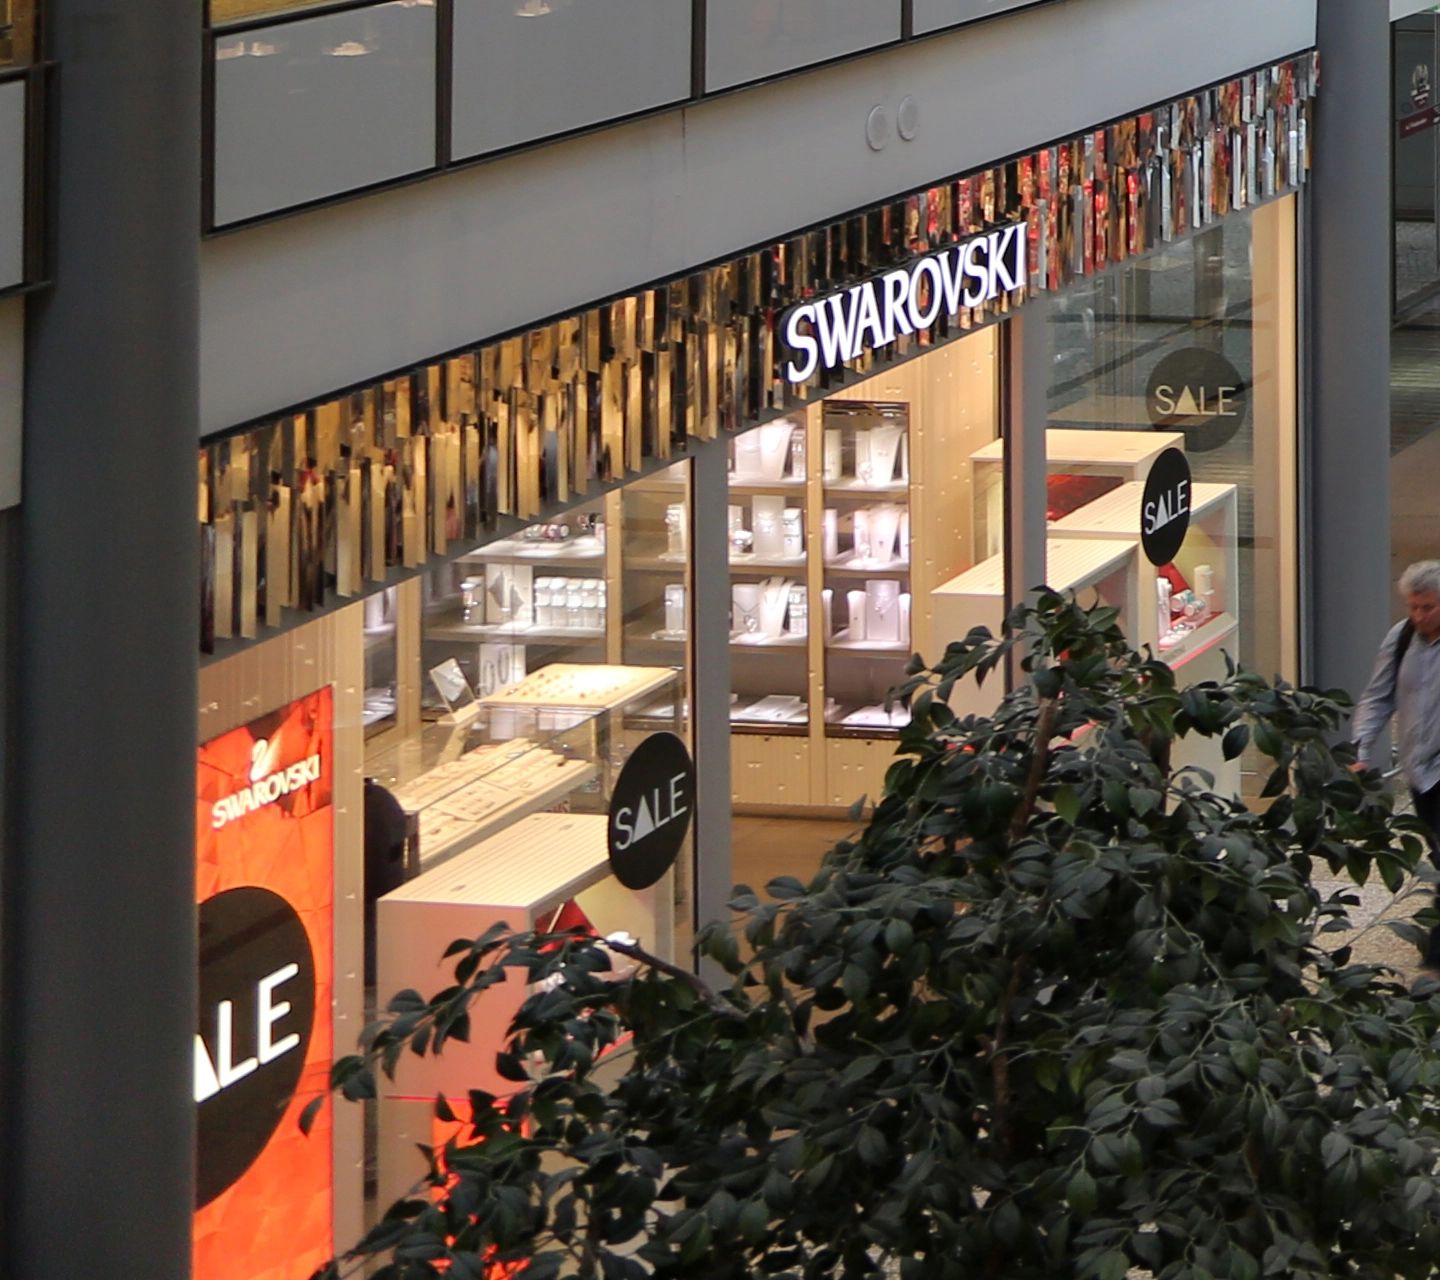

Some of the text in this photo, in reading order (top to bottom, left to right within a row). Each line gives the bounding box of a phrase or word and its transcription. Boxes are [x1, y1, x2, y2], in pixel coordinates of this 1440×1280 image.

[786, 222, 1028, 383] SWAROVSKI
[1155, 385, 1237, 417] SALE
[1144, 480, 1189, 536] SALE
[212, 755, 320, 830] SWAROVSKI
[614, 771, 688, 851] SALE
[194, 963, 301, 1104] ALE
